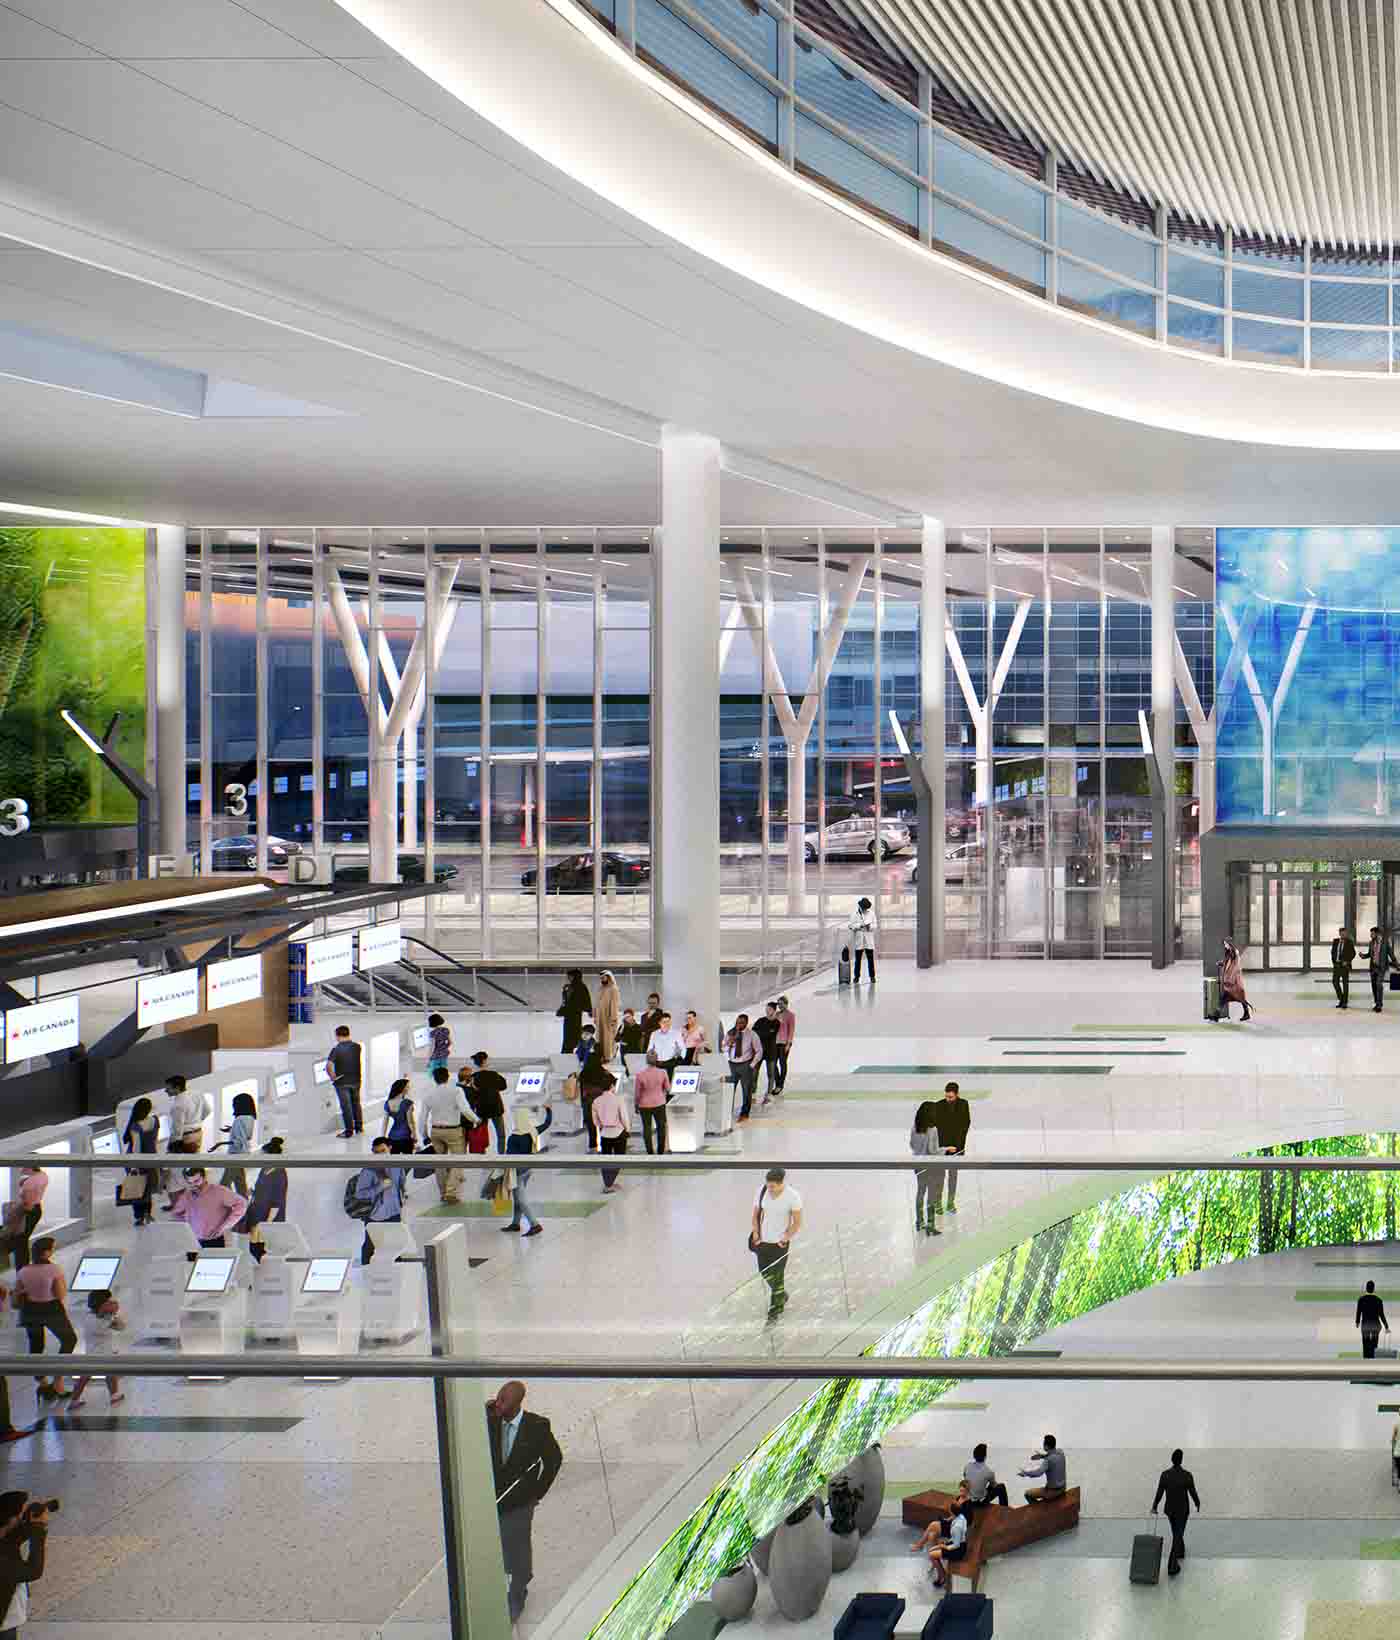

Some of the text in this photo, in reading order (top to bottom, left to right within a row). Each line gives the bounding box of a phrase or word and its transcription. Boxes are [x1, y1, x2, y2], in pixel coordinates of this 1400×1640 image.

[224, 783, 247, 816] 3
[0, 798, 30, 836] 3
[295, 856, 317, 883] D
[23, 1018, 75, 1038] AIR CANADA
